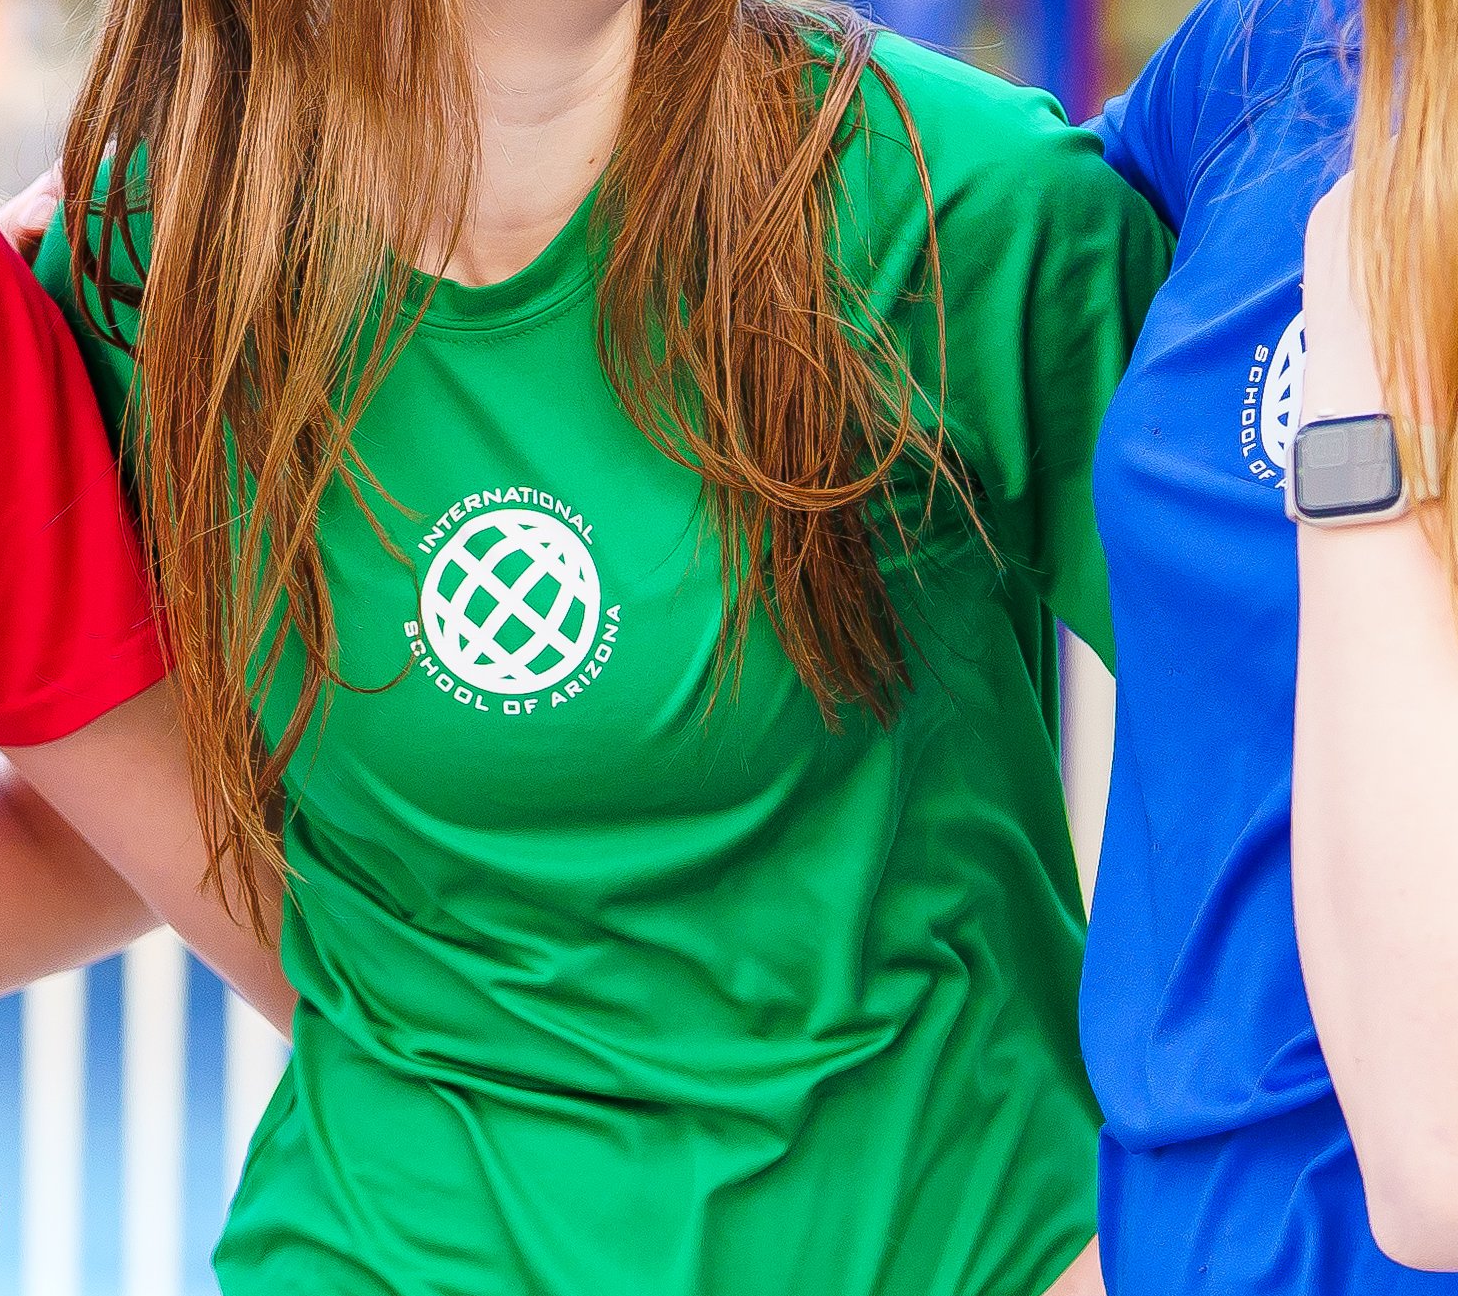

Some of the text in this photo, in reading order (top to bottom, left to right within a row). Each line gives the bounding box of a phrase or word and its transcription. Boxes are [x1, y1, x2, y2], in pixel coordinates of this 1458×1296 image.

[1240, 344, 1276, 481] SCHOOL OF
[417, 486, 595, 554] INTERNATIONAL
[403, 604, 622, 715] SCHOOL OF ARIZONA
